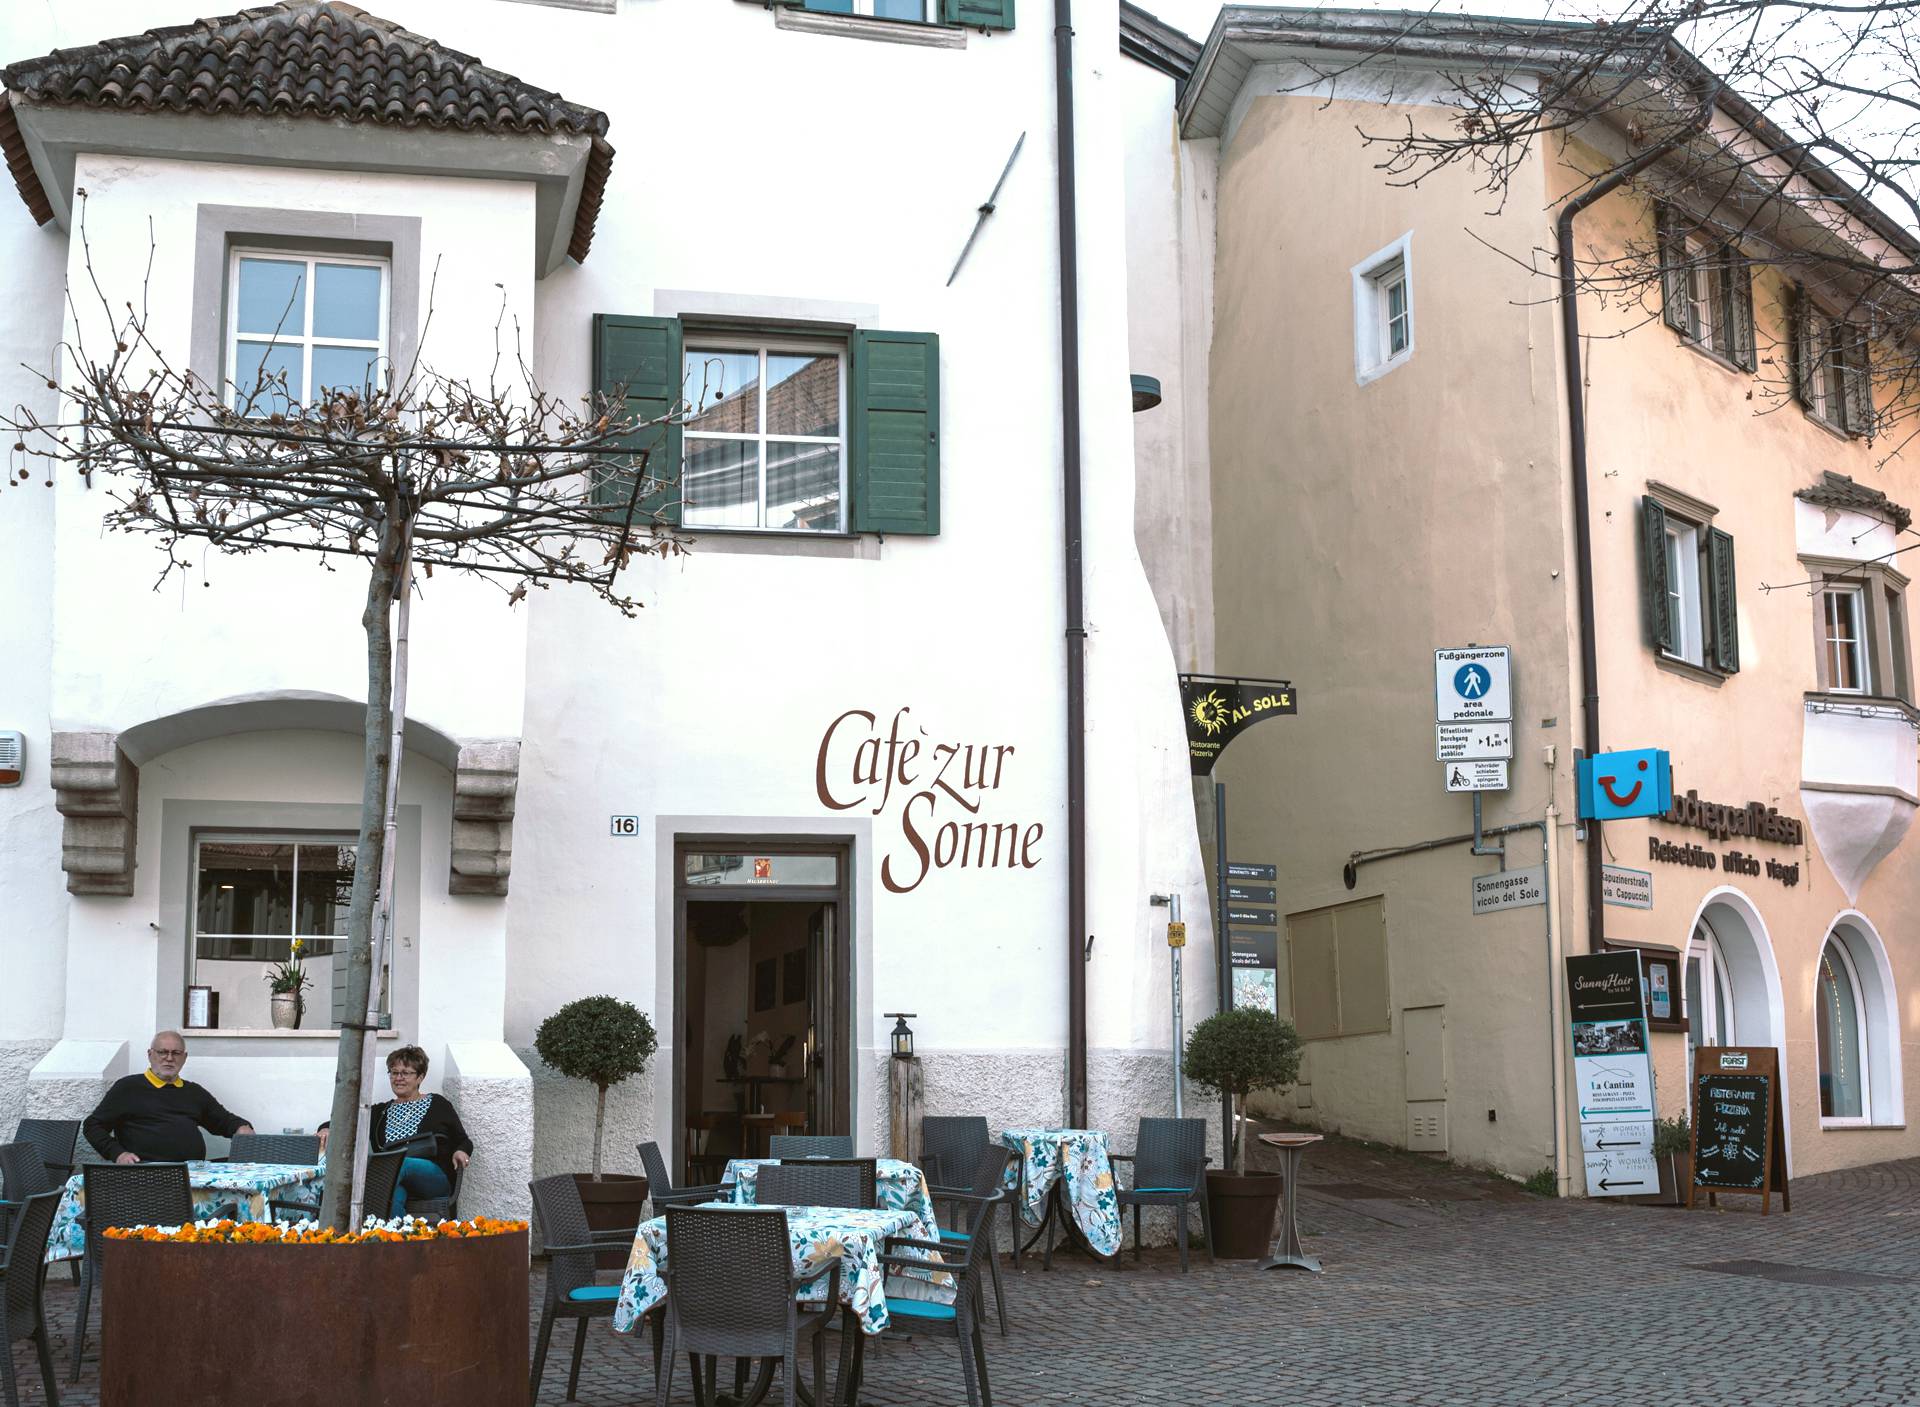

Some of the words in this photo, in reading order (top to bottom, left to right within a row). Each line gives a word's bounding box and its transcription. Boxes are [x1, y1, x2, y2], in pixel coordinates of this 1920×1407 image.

[1438, 651, 1505, 661] Fußgängerzone
[1232, 705, 1252, 724] AL
[1253, 694, 1290, 712] SOLE
[1463, 701, 1483, 709] area
[1453, 709, 1494, 719] pedonale
[1440, 726, 1473, 734] Öffentlicher
[1190, 741, 1220, 749] Ristorante
[1190, 750, 1213, 758] Pizzeria
[930, 742, 1015, 814] zur
[614, 818, 635, 834] 16
[880, 791, 1043, 894] Sonne
[1649, 836, 1716, 870] Reisebüro
[1722, 850, 1760, 877] ufficio
[1766, 858, 1799, 887] viaggi
[1477, 876, 1528, 892] Sonnengasse
[1477, 895, 1499, 907] vicolo
[1503, 891, 1516, 902] del
[1520, 888, 1539, 899] Sole
[1604, 886, 1612, 896] via
[1616, 887, 1649, 902] Cappuccini
[1722, 1057, 1746, 1065] FORST
[1592, 1081, 1601, 1090] La
[1603, 1080, 1635, 1090] Cantina
